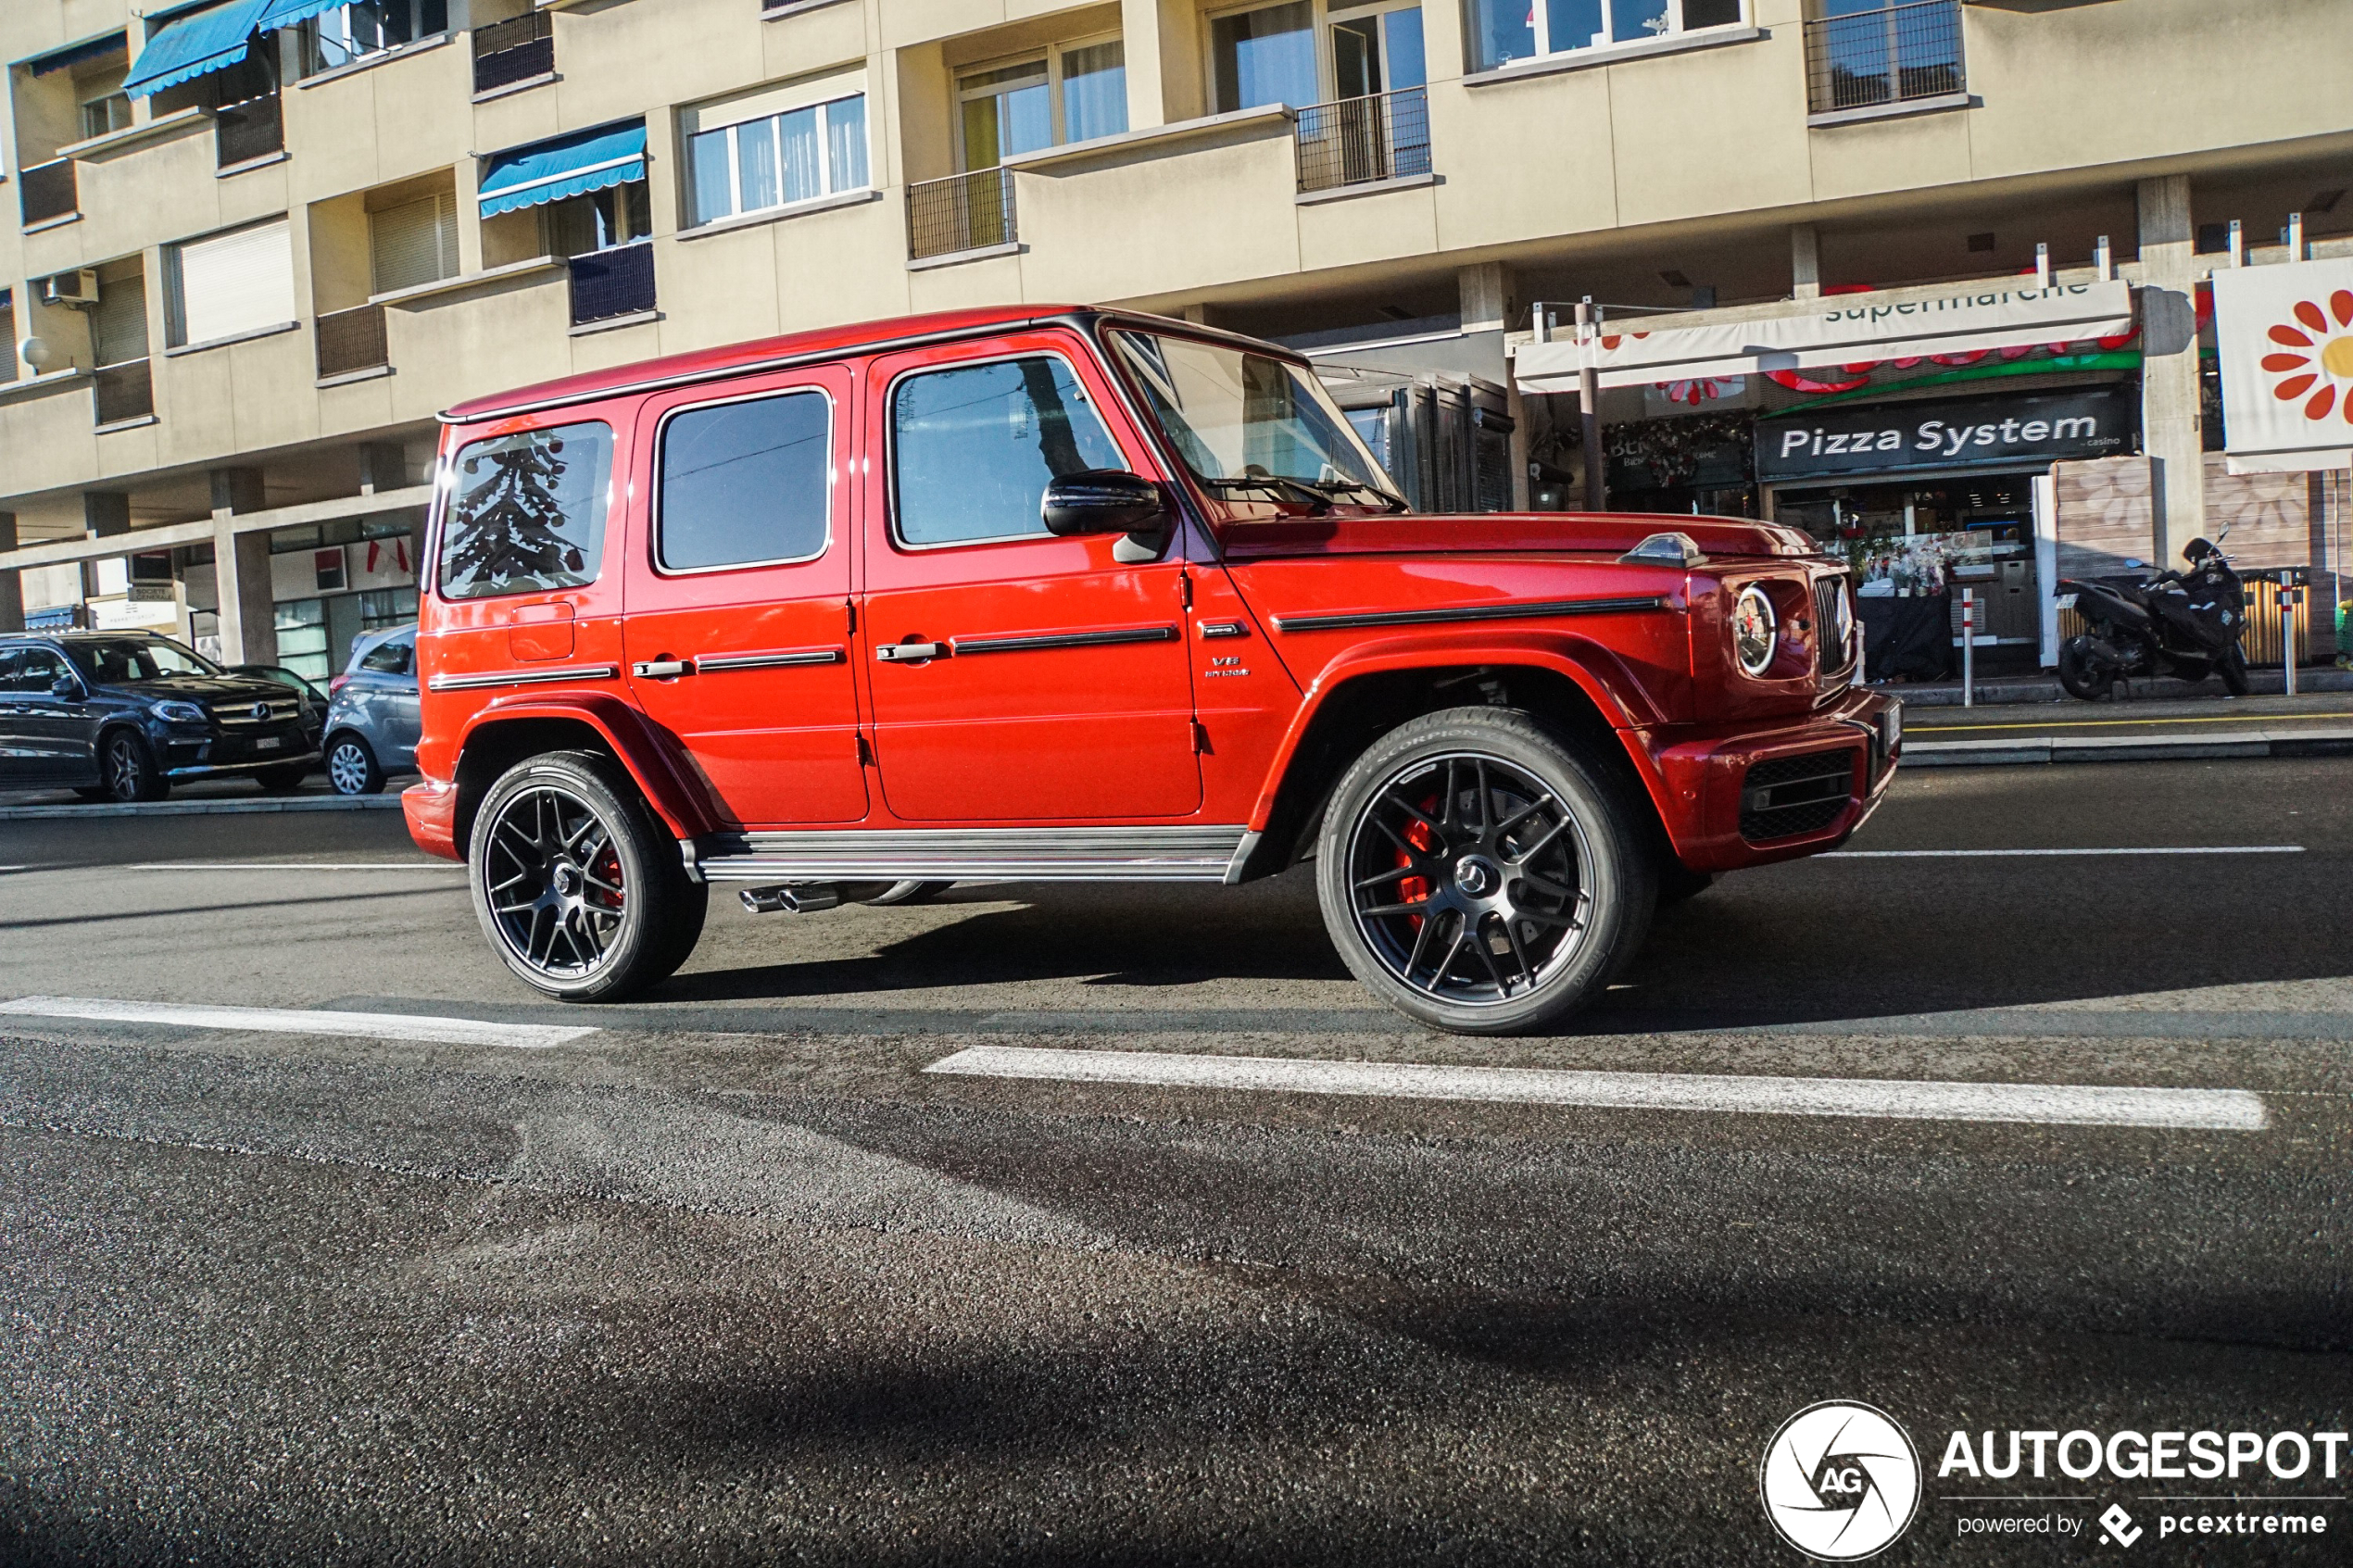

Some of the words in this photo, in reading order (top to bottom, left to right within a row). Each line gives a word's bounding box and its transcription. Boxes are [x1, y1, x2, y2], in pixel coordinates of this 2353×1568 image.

[1780, 427, 1902, 458] Pizza
[1914, 416, 2097, 456] System
[2087, 437, 2121, 446] casino
[1212, 657, 1239, 666] V8
[1377, 728, 1479, 763] SCORPION
